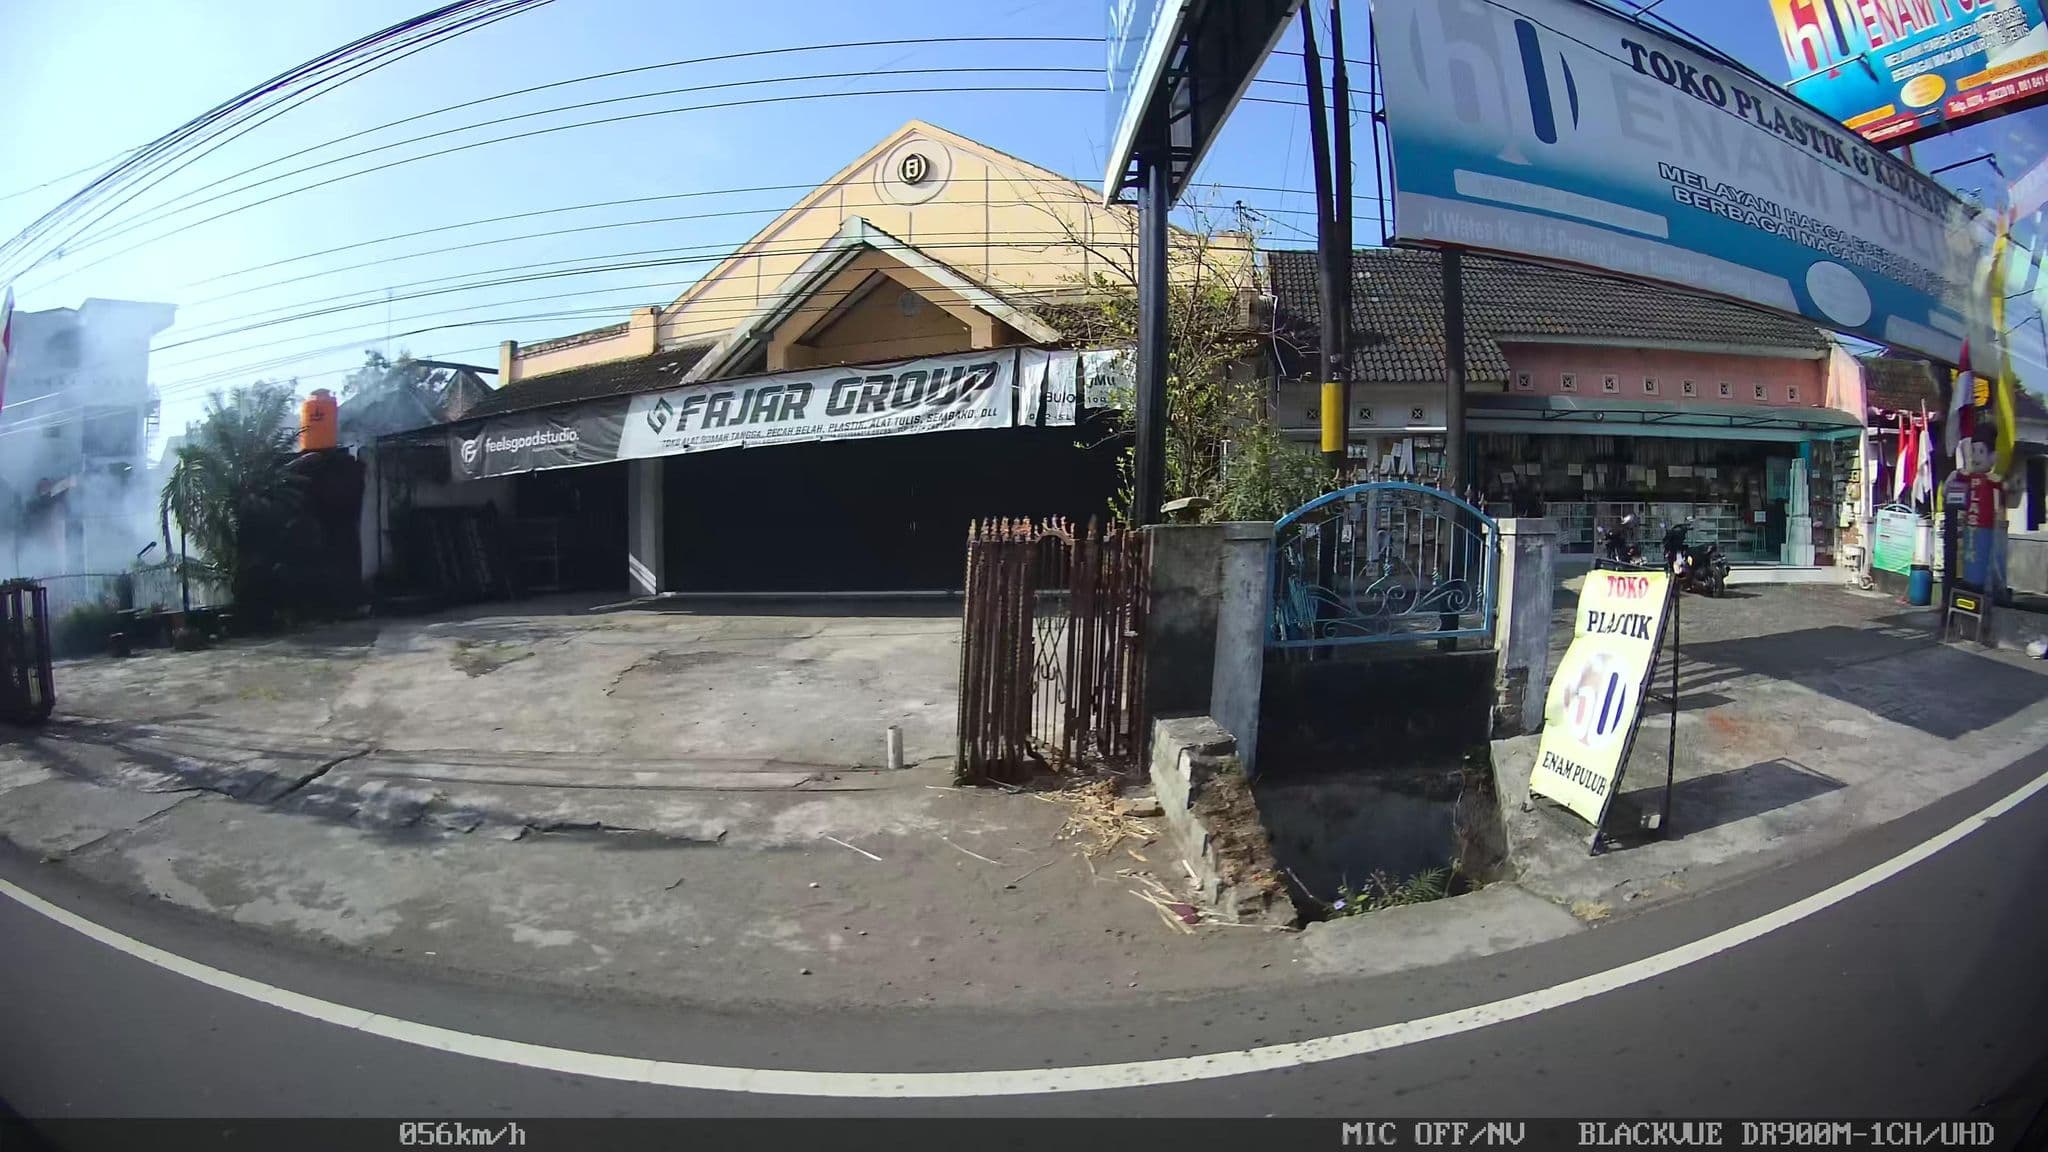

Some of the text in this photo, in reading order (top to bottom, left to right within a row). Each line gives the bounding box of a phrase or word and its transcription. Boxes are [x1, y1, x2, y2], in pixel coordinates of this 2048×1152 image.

[1622, 38, 1727, 107] TOKO
[1731, 85, 1850, 168] PLASTIK
[1851, 146, 1869, 176] &
[1657, 161, 1781, 220] MELAYANI
[1784, 208, 1850, 243] HARGA
[1672, 186, 1796, 241] BERBAGAI
[1800, 231, 1865, 267] MACAM
[676, 361, 1001, 432] FAJAR GROUP
[980, 407, 998, 418] DLL
[1607, 575, 1649, 598] TOKO
[1586, 610, 1653, 640] PLASTIK
[1542, 750, 1574, 781] ENAM
